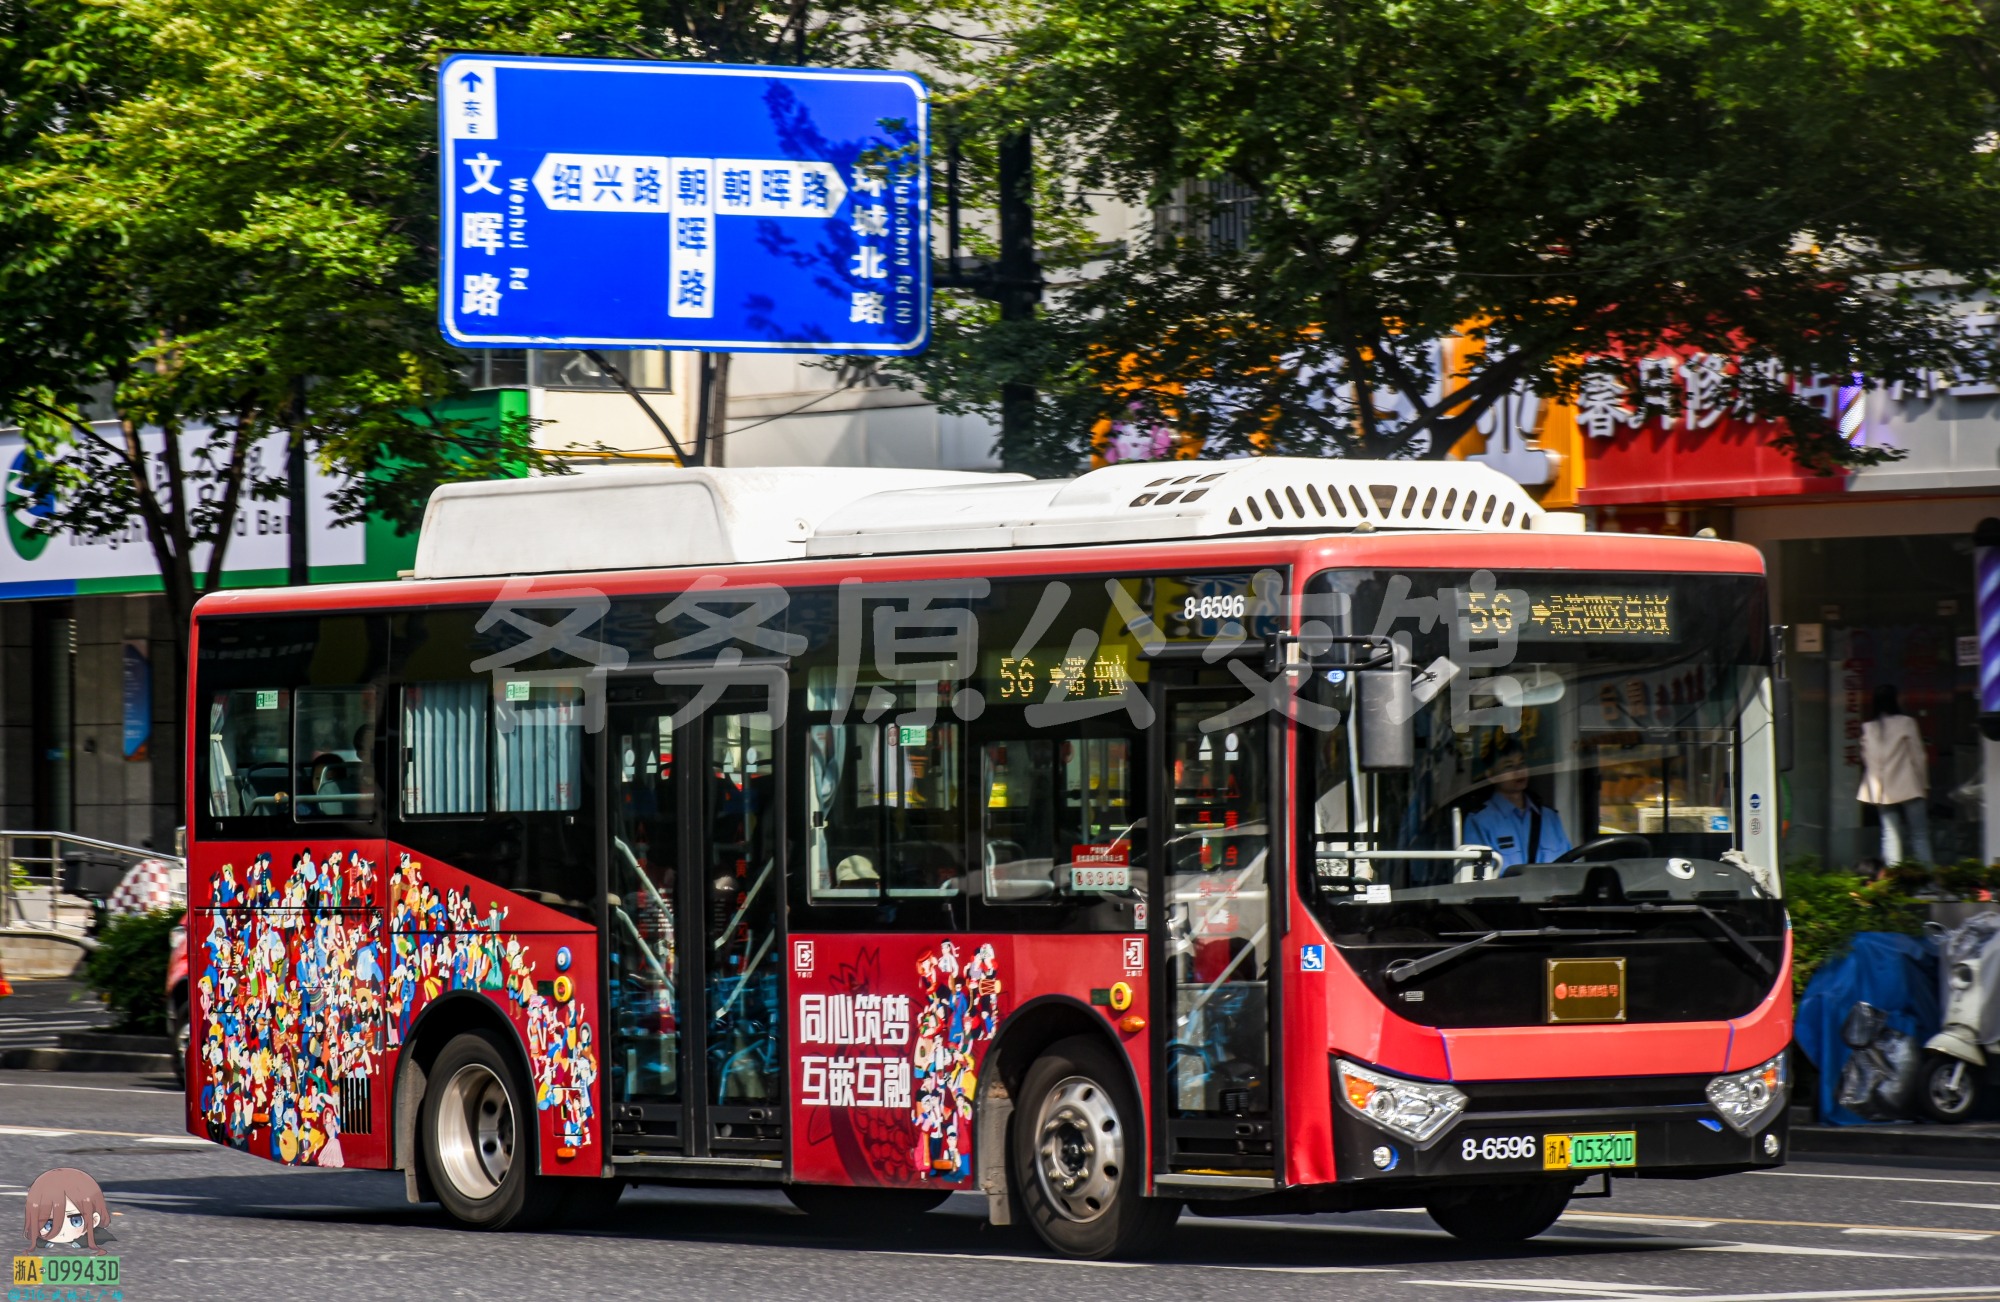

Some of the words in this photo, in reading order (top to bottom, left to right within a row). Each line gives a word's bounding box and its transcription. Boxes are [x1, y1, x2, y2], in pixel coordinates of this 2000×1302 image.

[463, 99, 482, 117] 东
[467, 123, 478, 134] E
[551, 163, 663, 206] 绍兴路
[720, 167, 831, 211] 朝晖路
[460, 152, 505, 317] 文晖路
[508, 178, 530, 249] Wenhui
[677, 166, 709, 309] 朝晖路
[508, 267, 530, 290] Rd
[1183, 594, 1245, 620] 8-6596
[1468, 592, 1513, 634] 56
[1001, 657, 1035, 698] 56
[1567, 985, 1619, 998] 民族团结号
[800, 994, 910, 1045] 同心筑梦
[801, 1056, 911, 1108] 互嵌互融
[1461, 1135, 1536, 1161] 8-6596
